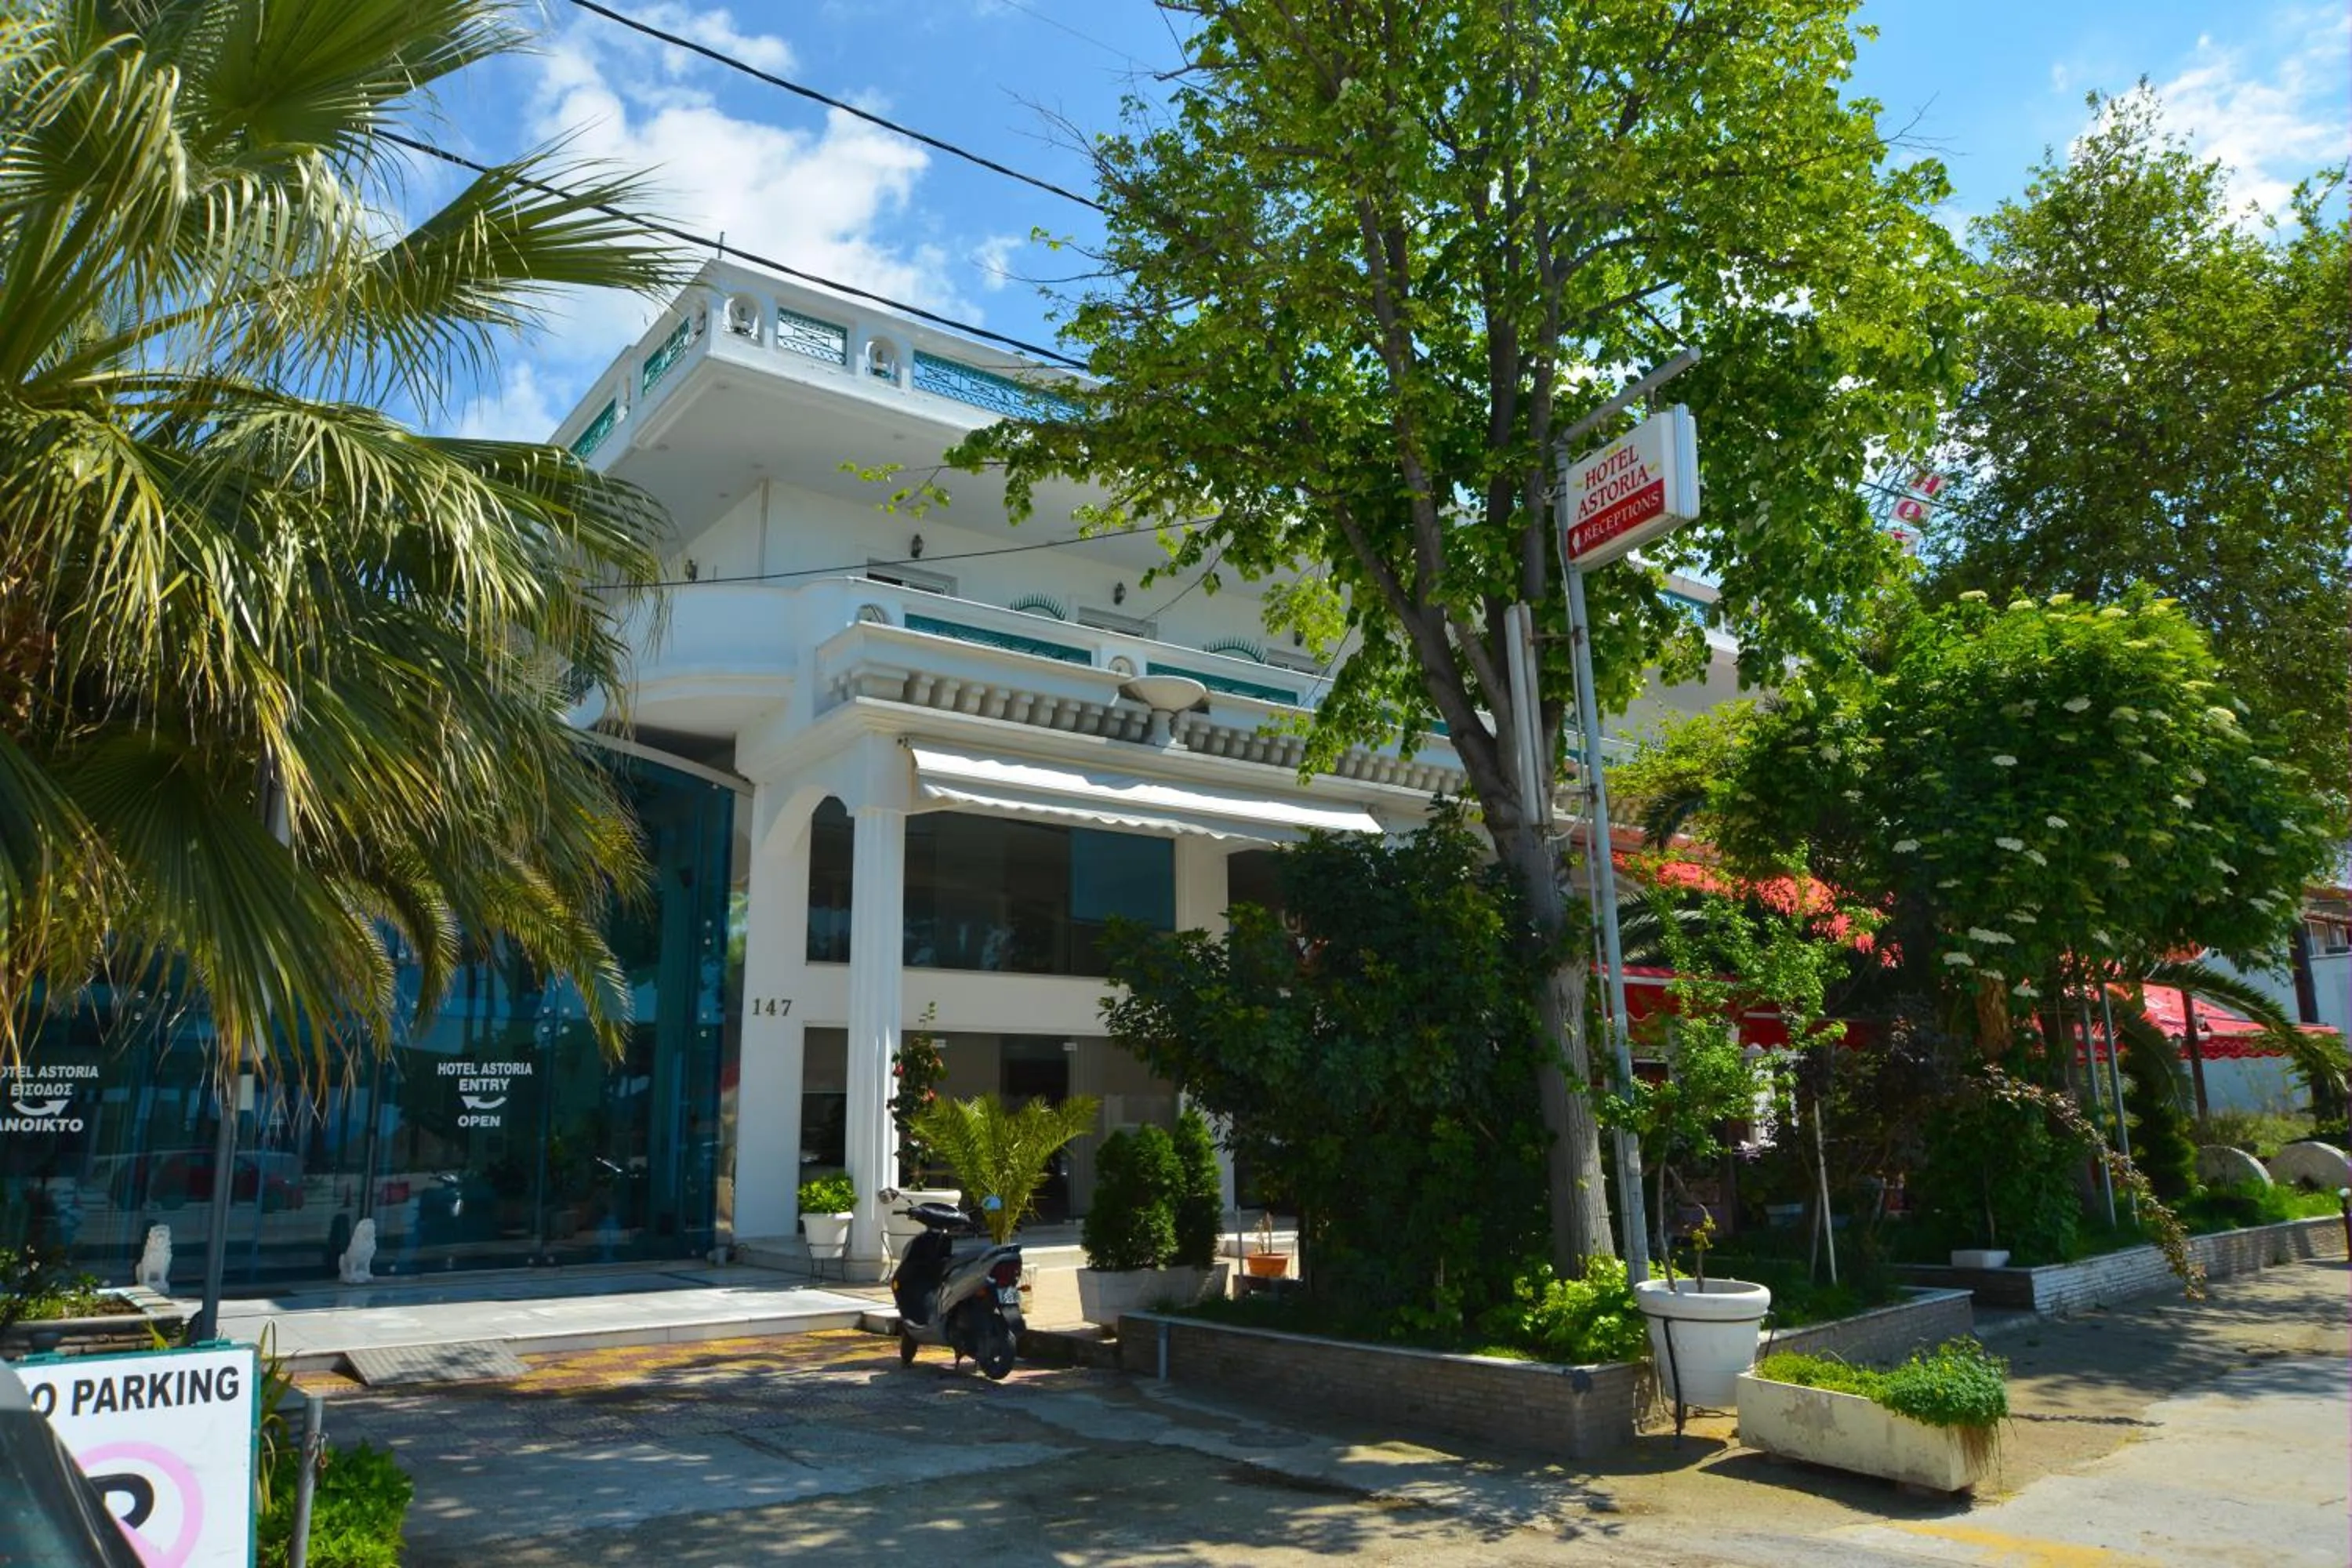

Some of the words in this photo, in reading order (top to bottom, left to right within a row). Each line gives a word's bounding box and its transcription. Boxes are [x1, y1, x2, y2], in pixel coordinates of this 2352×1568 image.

[1585, 445, 1639, 490] HOTEL
[1577, 464, 1650, 519] ASTORIA
[1584, 491, 1659, 543] RECEPTIONS
[753, 997, 792, 1016] 147
[38, 1065, 99, 1078] ASTORIA
[437, 1062, 477, 1075] HOTEL
[481, 1062, 532, 1075] ASTORIA
[10, 1083, 74, 1097] ΕΙΣΟΔΟΣ
[459, 1078, 510, 1091] ENTRY
[0, 1118, 84, 1132] ΝΟΙΚΤΟ
[458, 1115, 501, 1127] OPEN
[31, 1382, 57, 1418] O
[71, 1367, 239, 1416] PARKING
